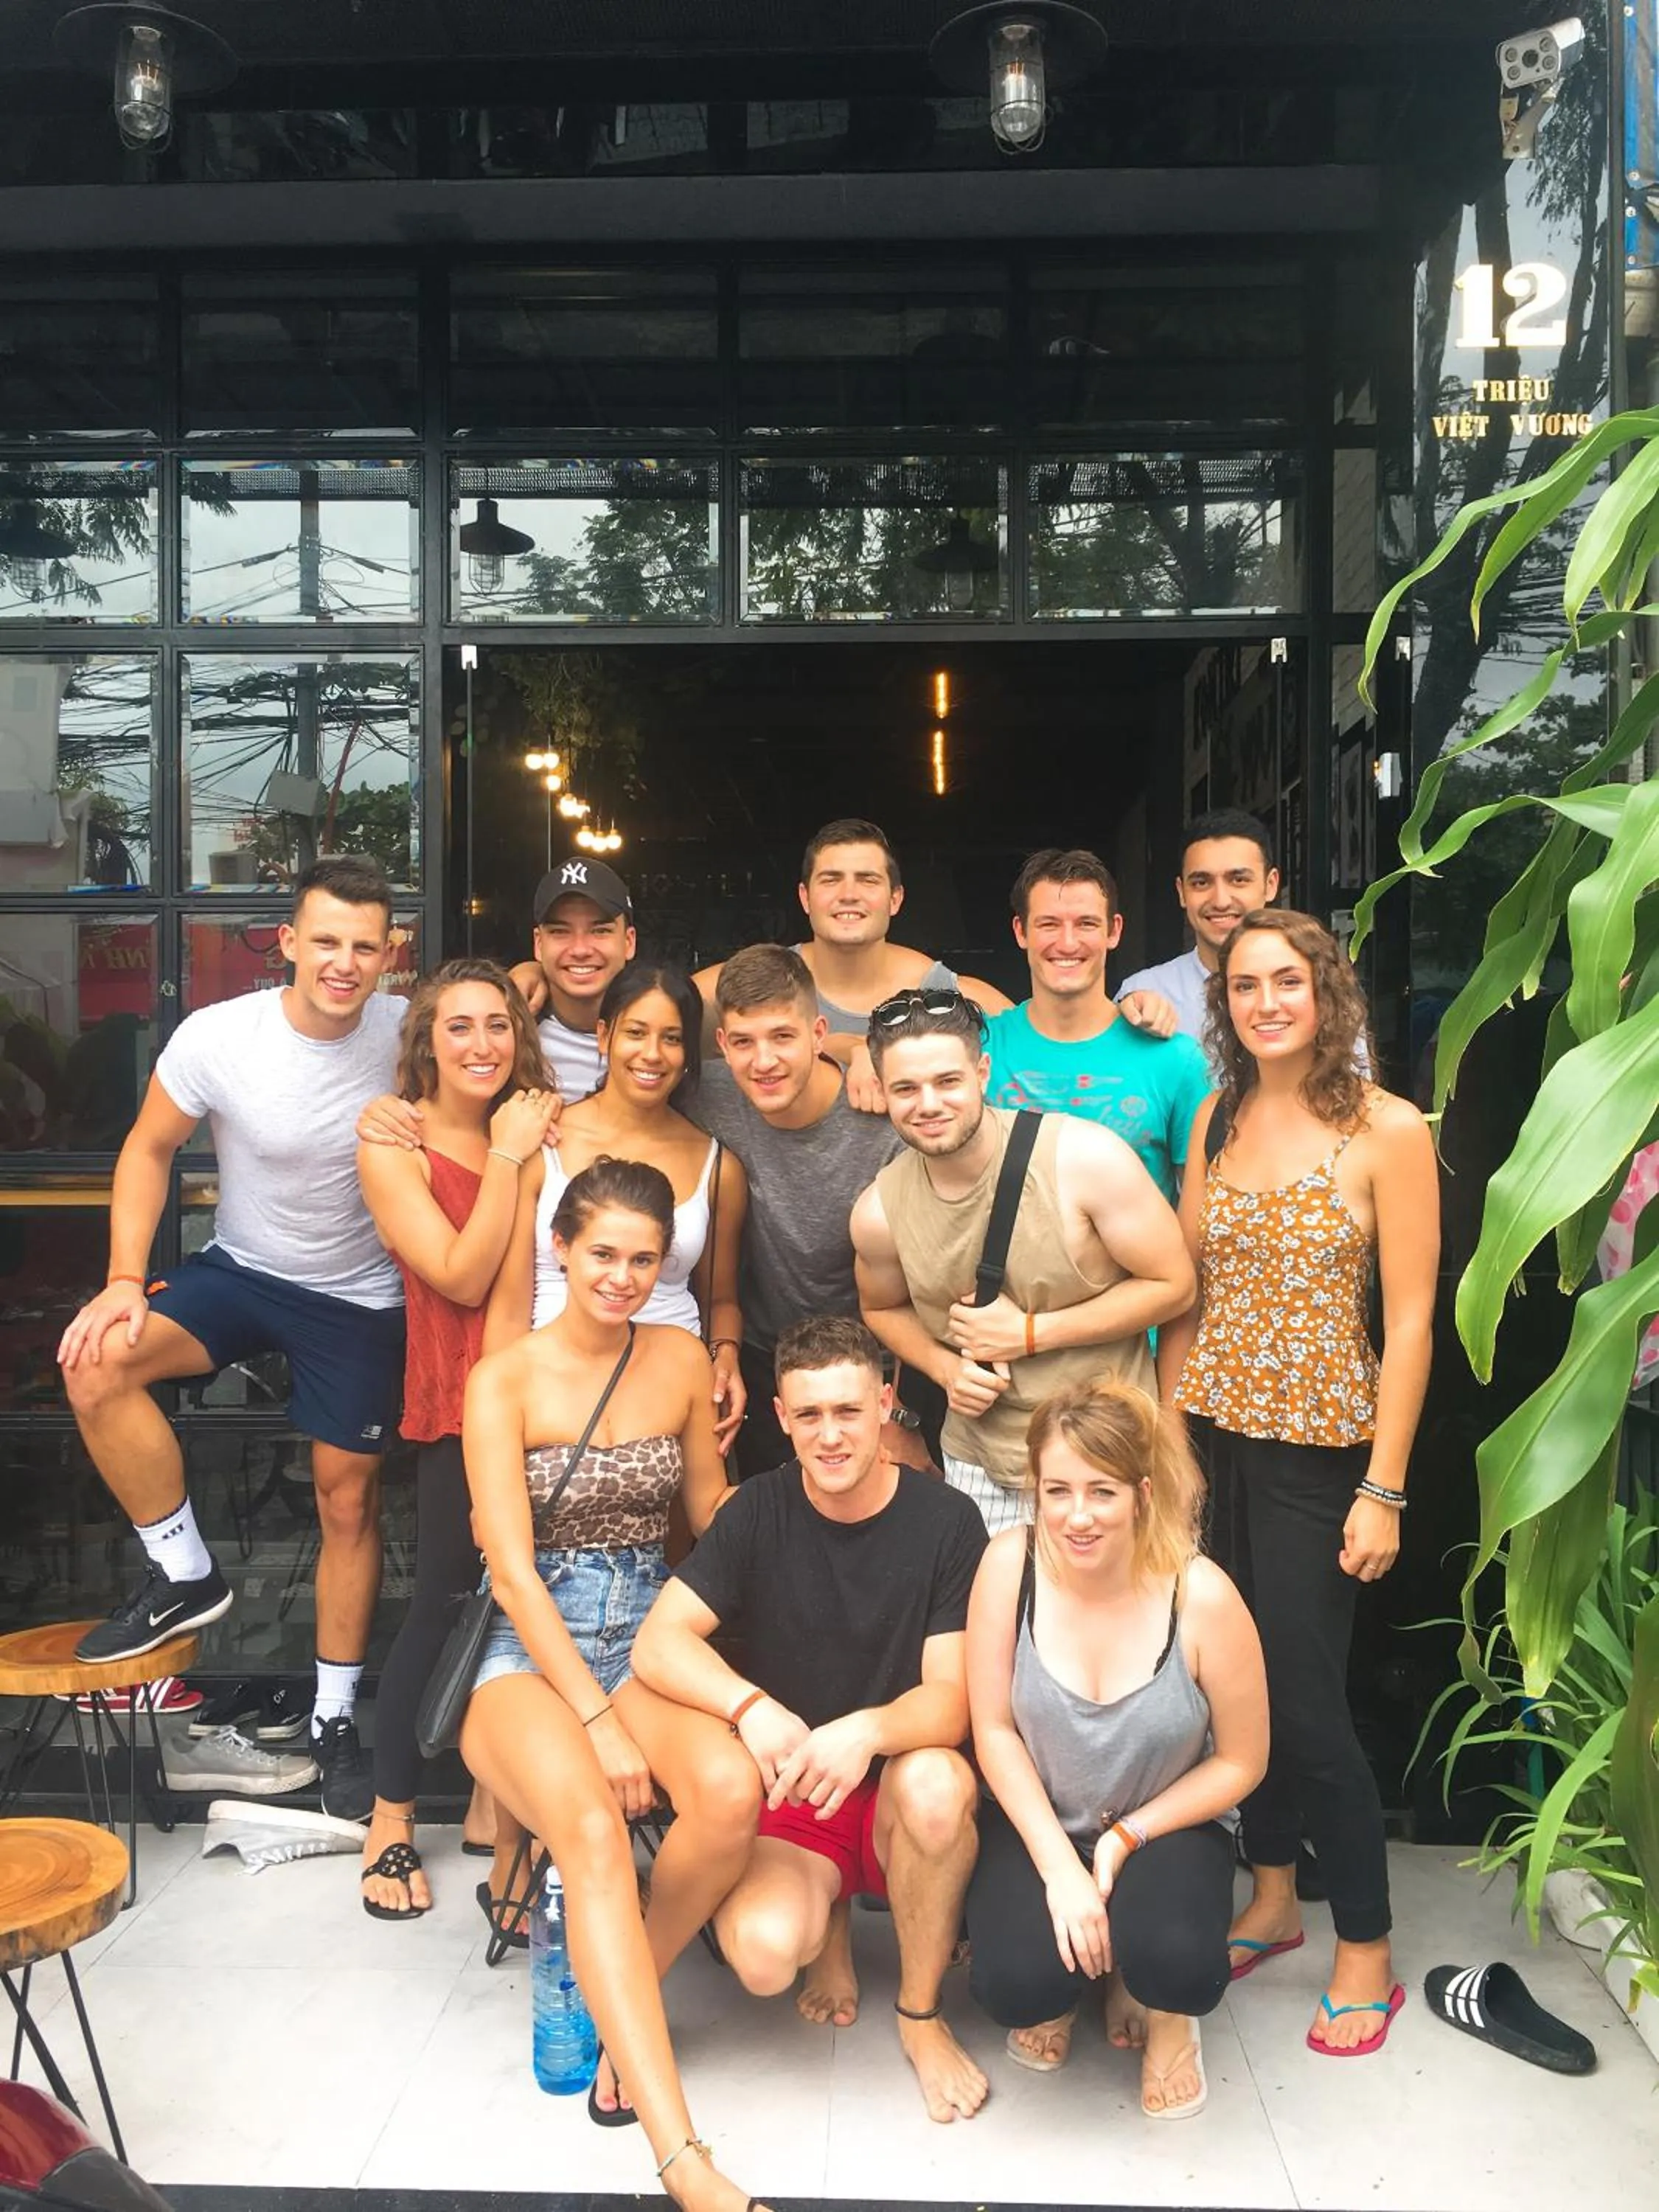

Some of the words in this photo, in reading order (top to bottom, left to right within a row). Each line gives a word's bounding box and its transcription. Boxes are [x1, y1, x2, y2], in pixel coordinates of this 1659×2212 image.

[1455, 263, 1567, 347] 12
[1473, 375, 1549, 405] TRIỆU
[1433, 412, 1489, 440] VIỆT
[1511, 412, 1593, 436] VƯƠNG
[561, 862, 588, 884] NY
